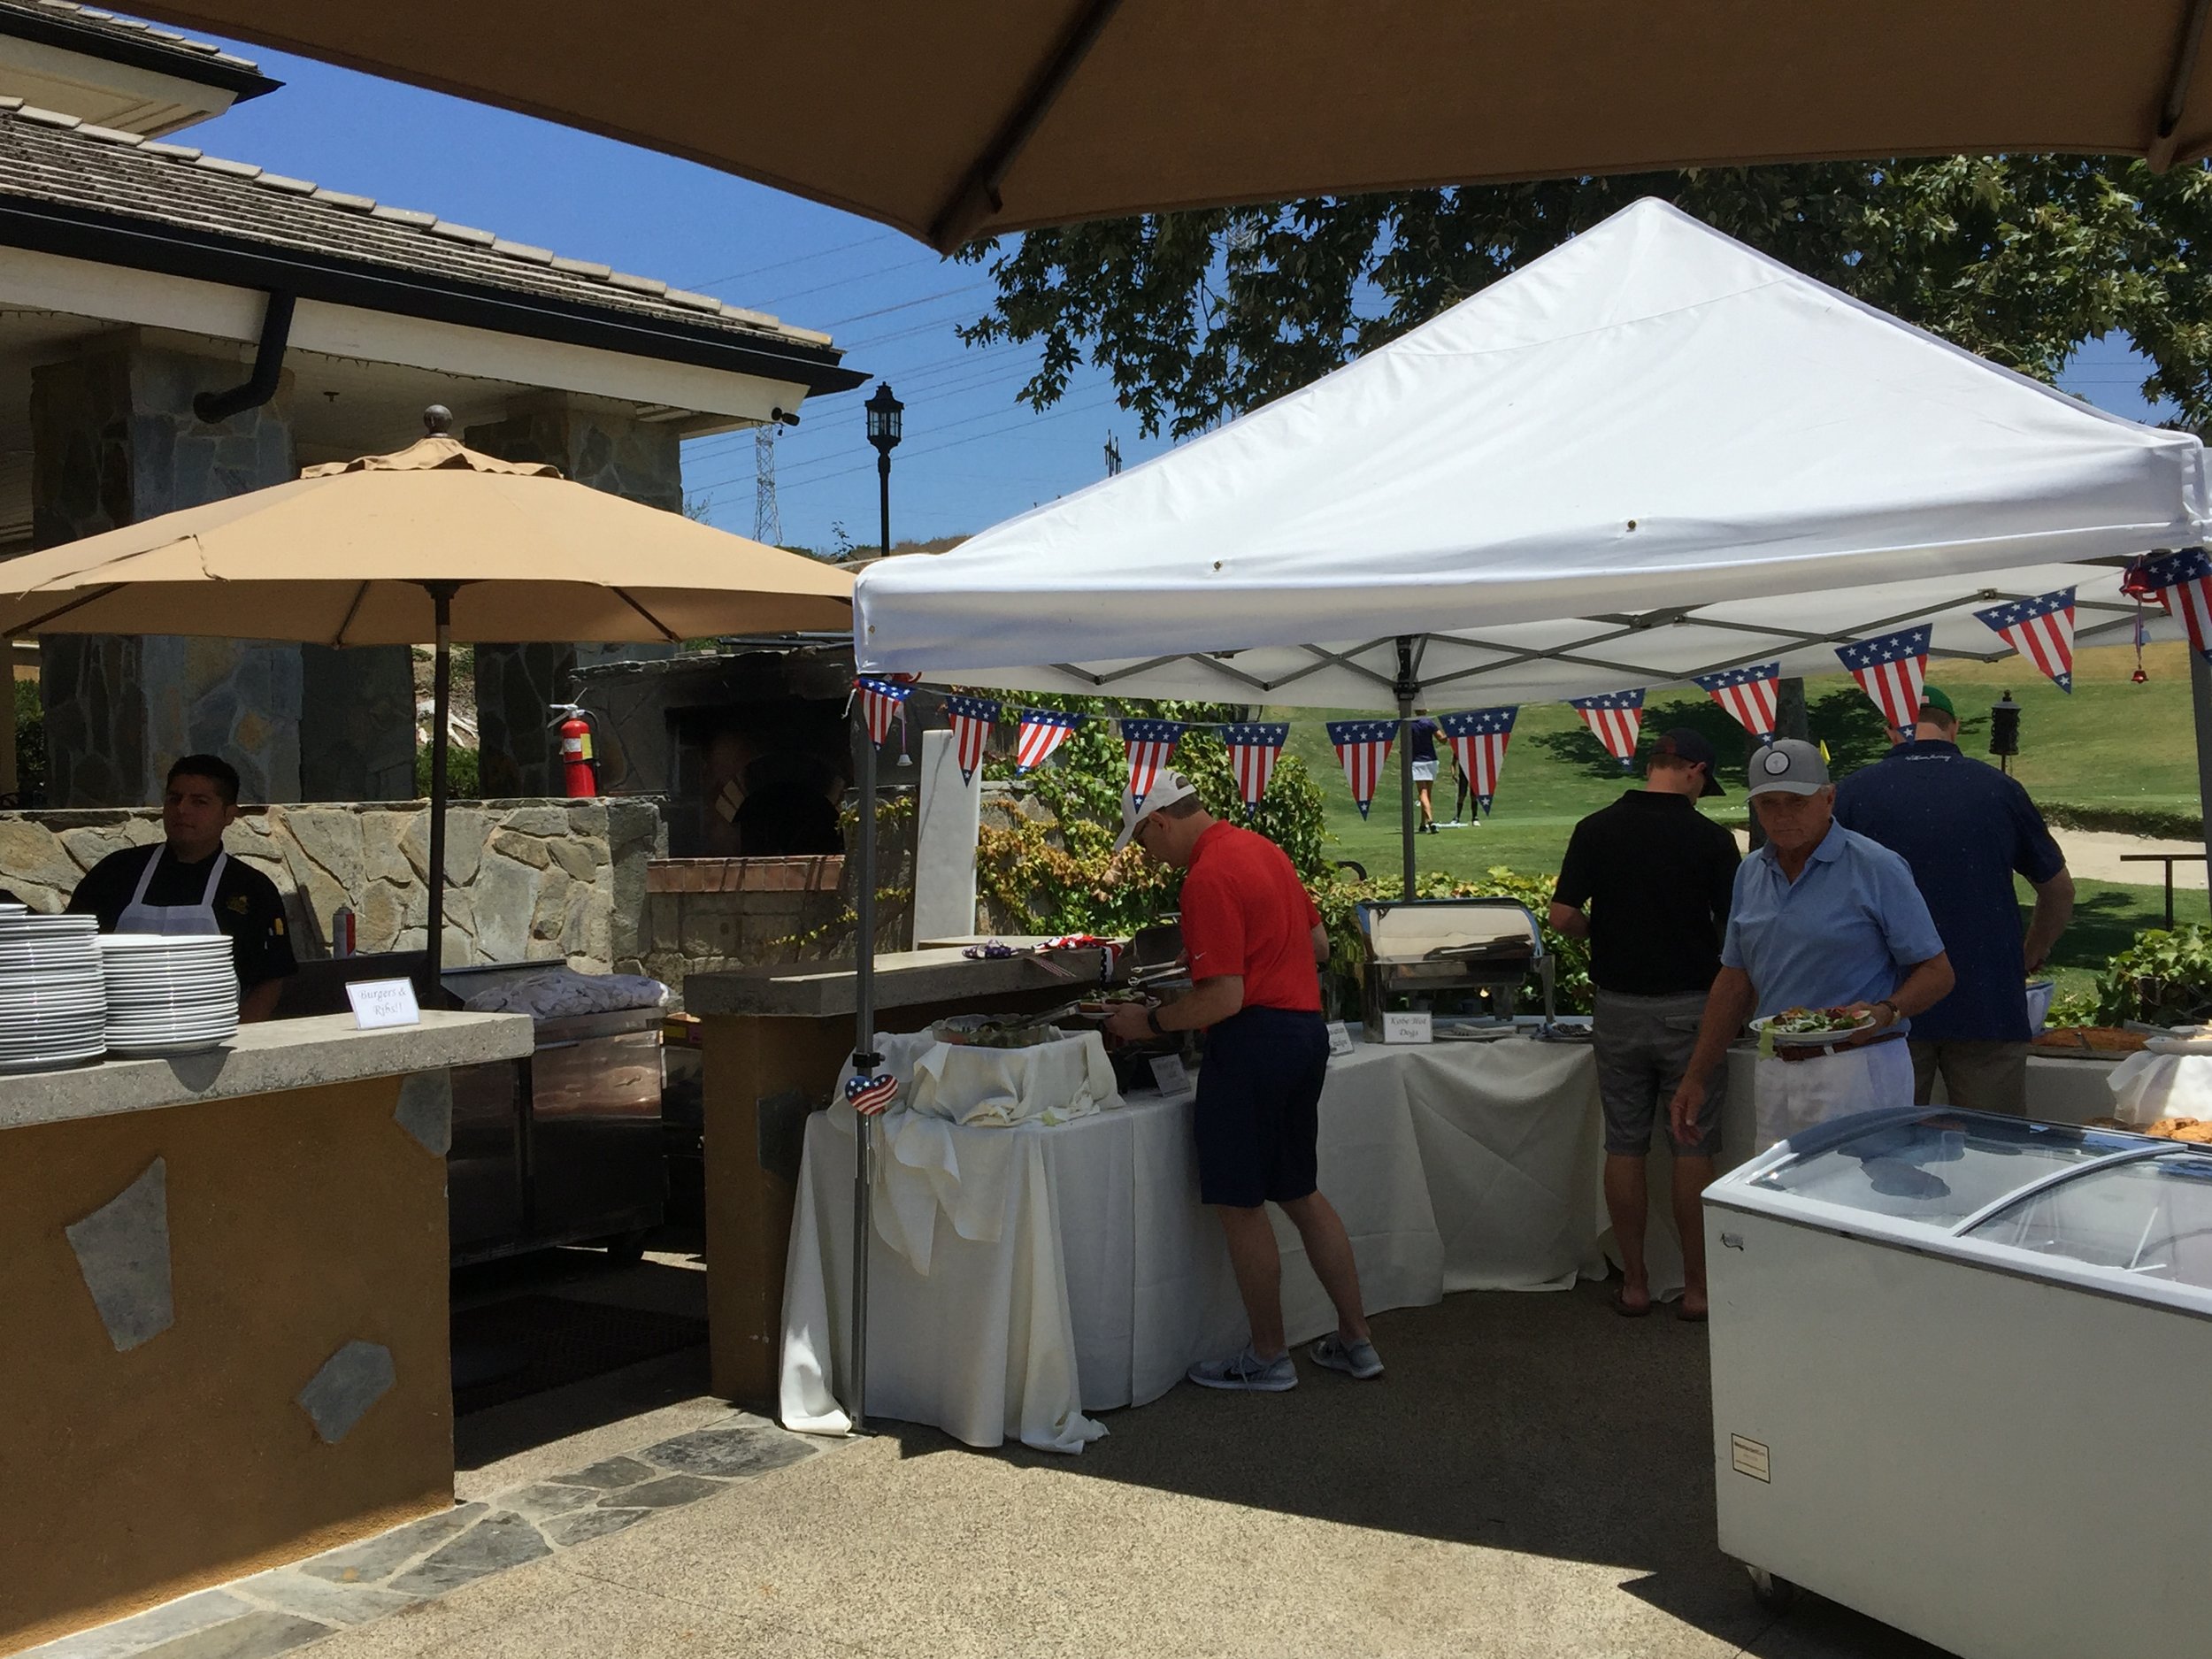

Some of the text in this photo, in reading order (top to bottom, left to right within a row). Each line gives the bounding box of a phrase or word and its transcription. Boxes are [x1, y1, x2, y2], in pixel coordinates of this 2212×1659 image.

[359, 987, 407, 1002] Burgers &
[1399, 1028, 1419, 1038] Dogs
